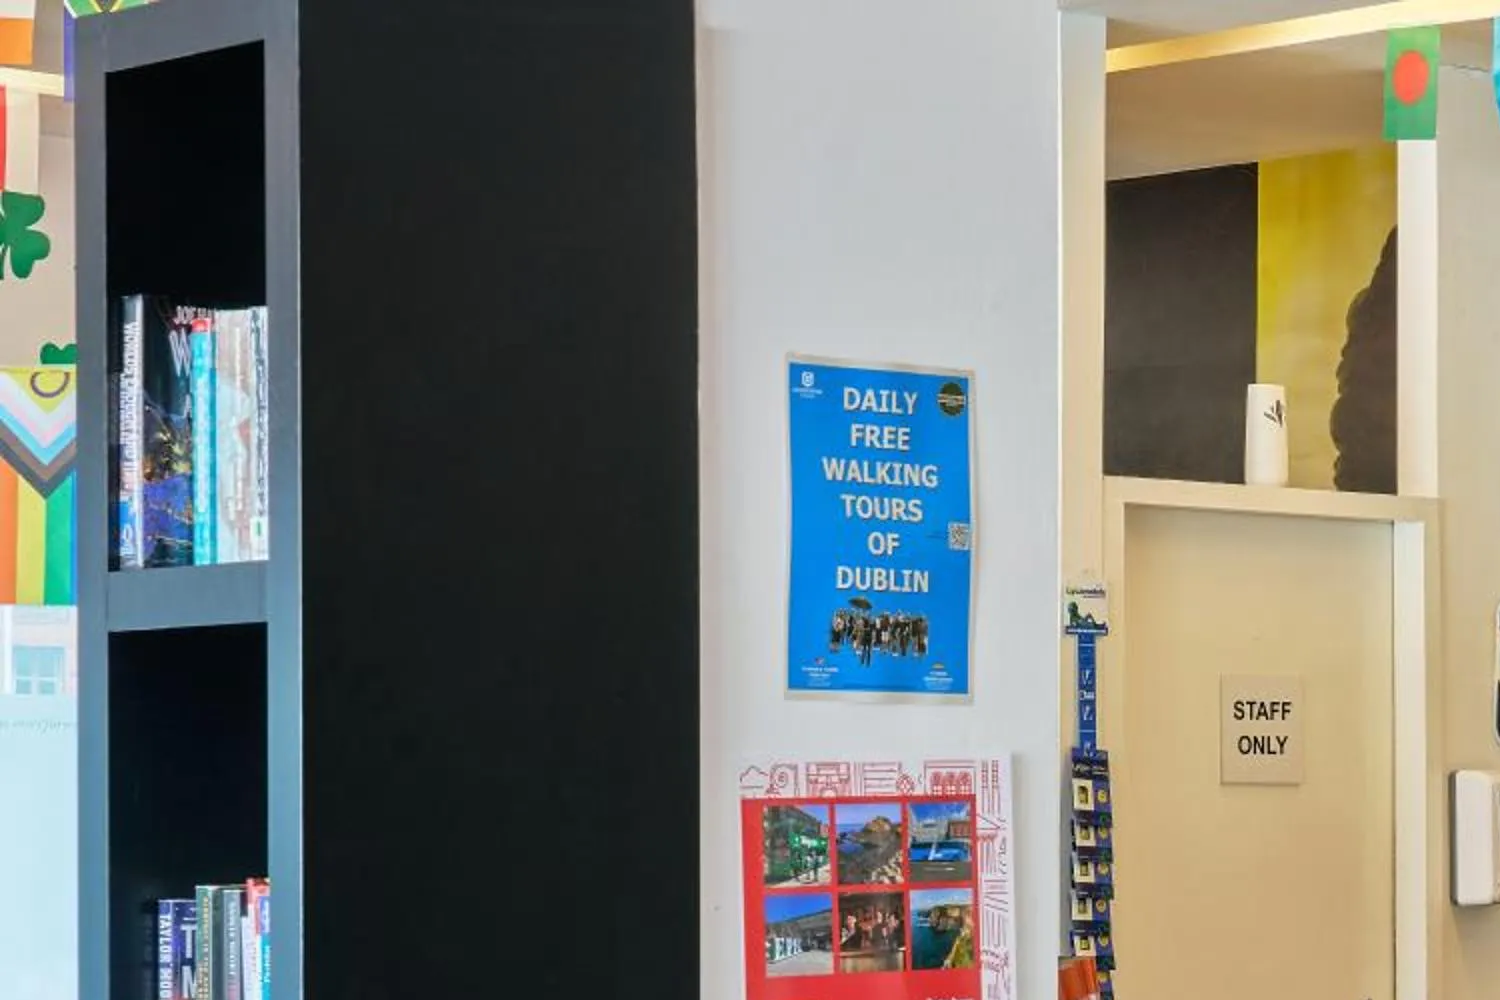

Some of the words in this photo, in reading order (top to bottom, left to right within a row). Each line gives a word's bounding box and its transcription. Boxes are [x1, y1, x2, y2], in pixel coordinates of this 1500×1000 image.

[843, 386, 918, 415] DAILY
[850, 423, 910, 450] FREE
[822, 457, 938, 488] WALKING
[840, 494, 923, 521] TOURS
[867, 531, 900, 556] OF
[835, 566, 929, 593] DUBLIN
[1233, 701, 1292, 720] STAFF
[1238, 735, 1288, 755] ONLY
